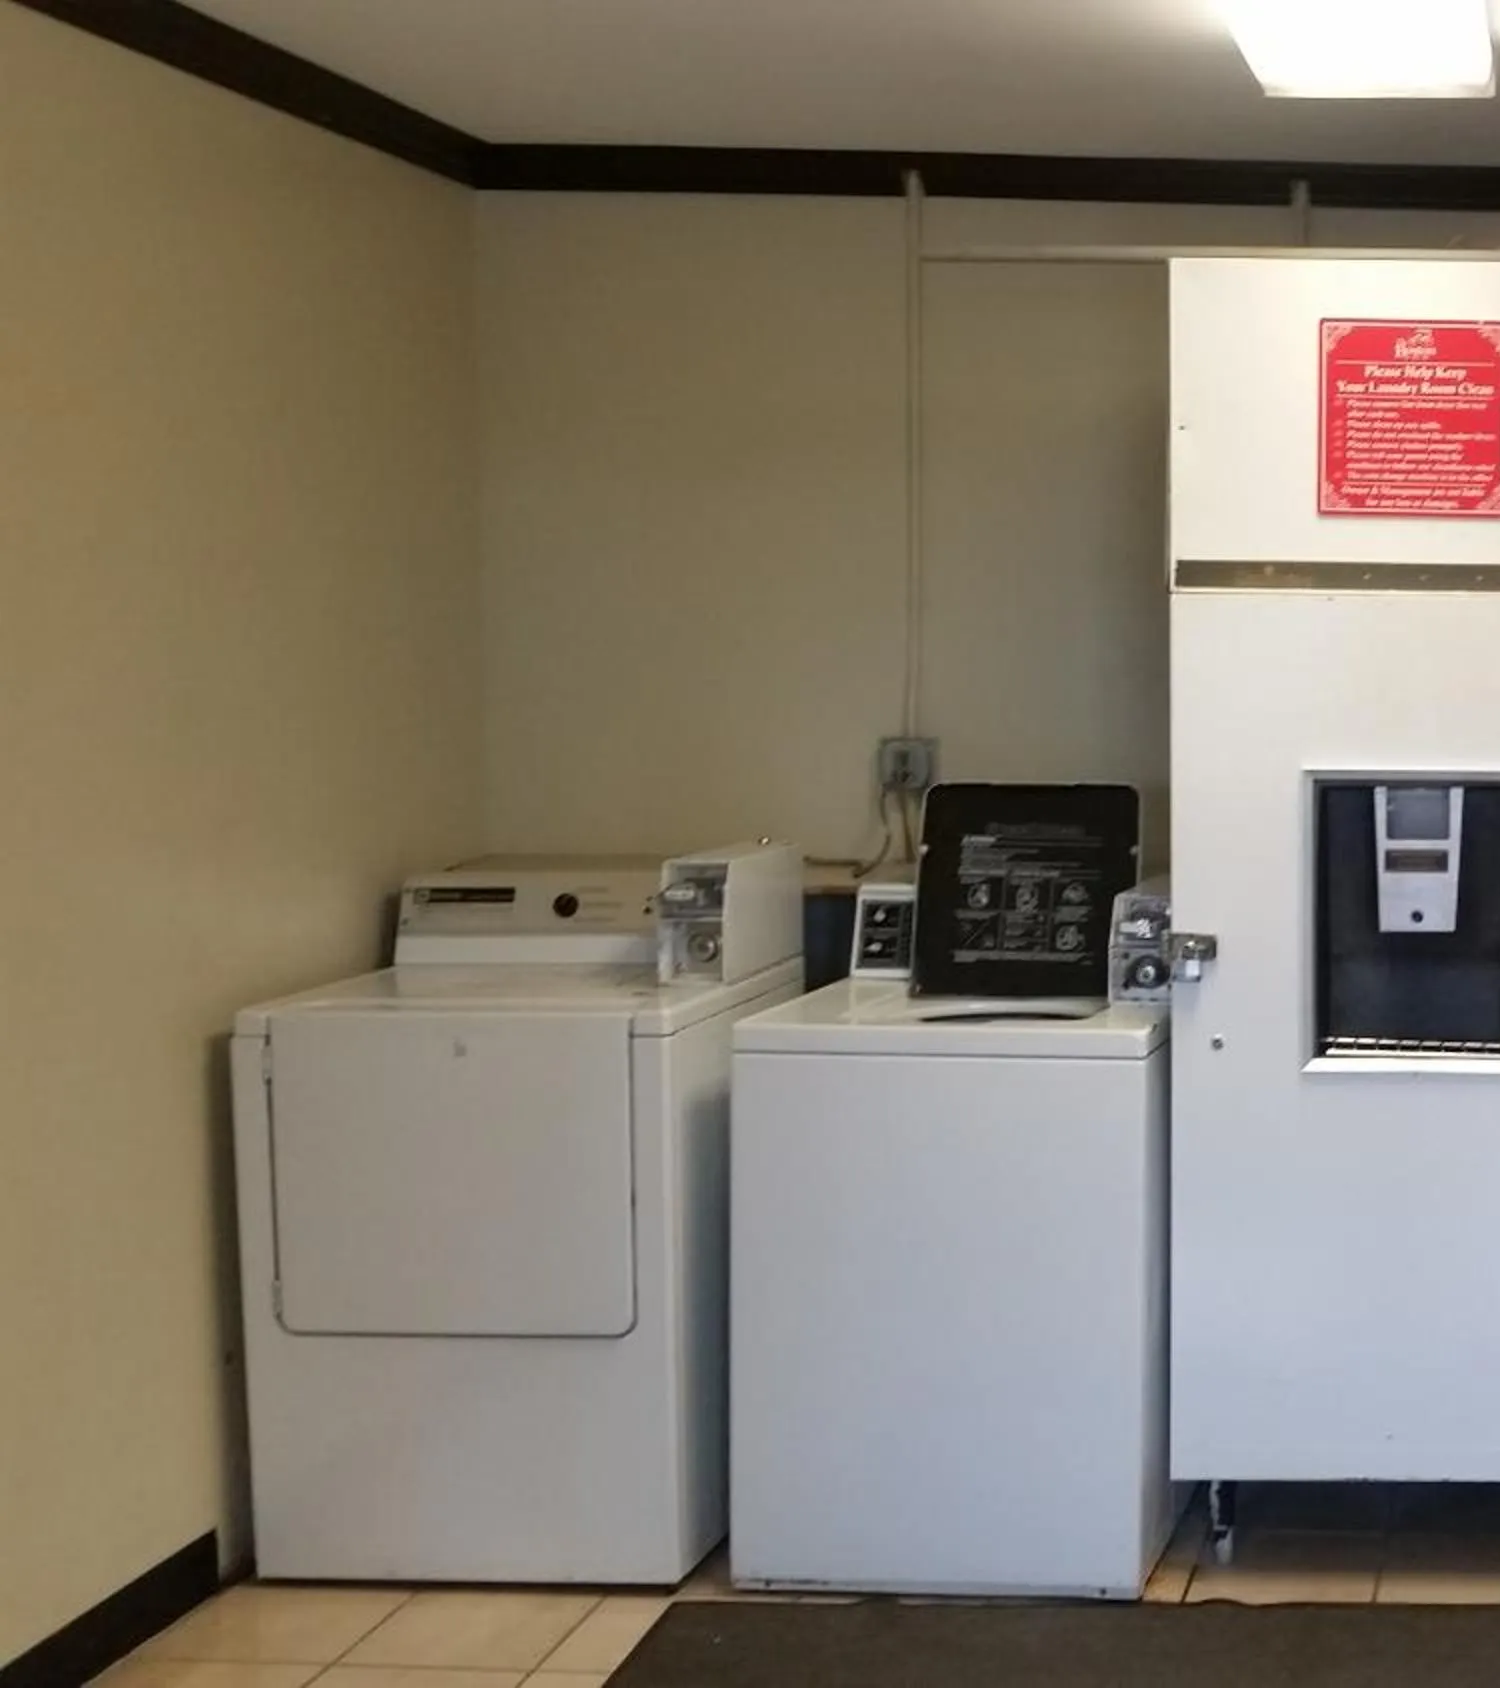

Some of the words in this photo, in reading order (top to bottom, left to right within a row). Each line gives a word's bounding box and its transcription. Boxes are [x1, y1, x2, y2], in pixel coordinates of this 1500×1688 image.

[1364, 365, 1401, 378] Please
[1404, 366, 1432, 380] Help
[1435, 367, 1467, 381] Keep
[1336, 380, 1367, 393] Your
[1368, 382, 1418, 395] Laundry
[1420, 382, 1456, 395] Room
[1458, 383, 1495, 395] Clean
